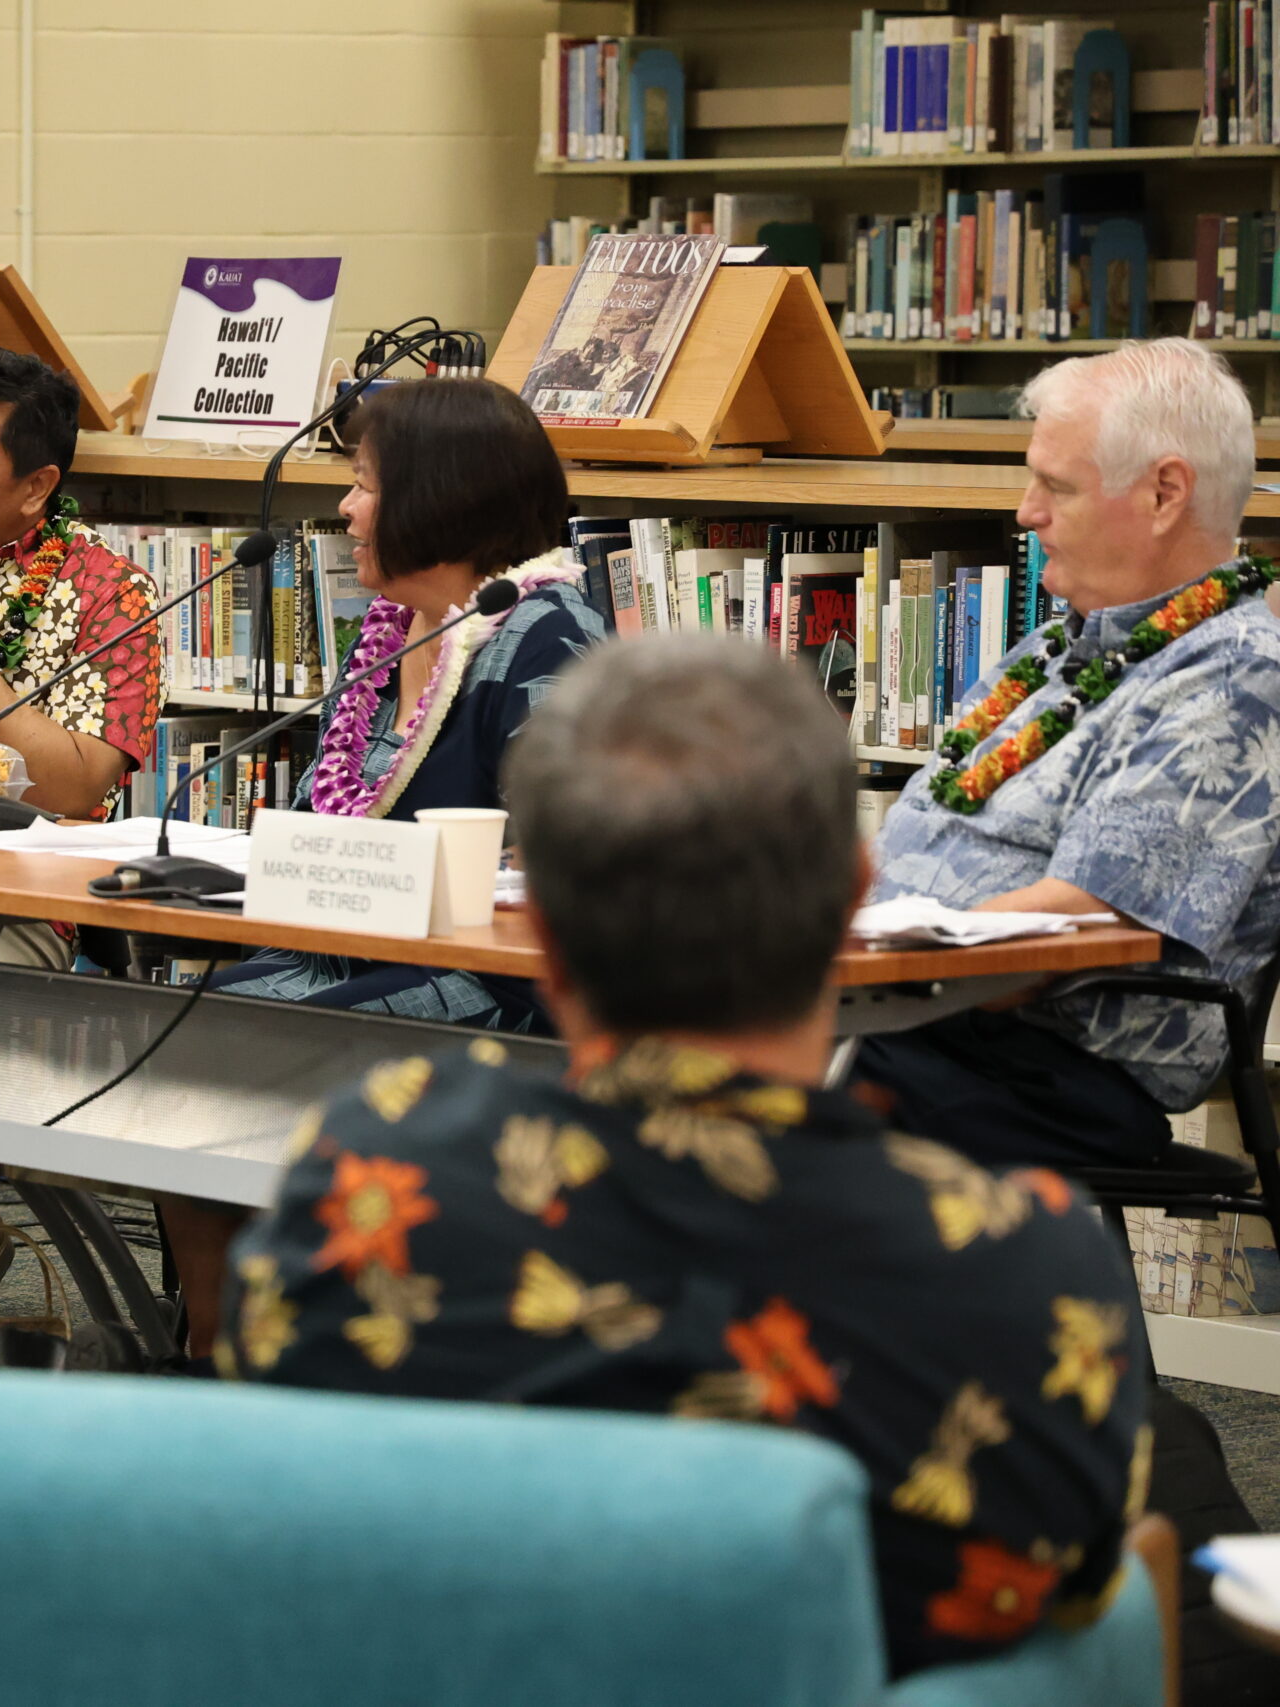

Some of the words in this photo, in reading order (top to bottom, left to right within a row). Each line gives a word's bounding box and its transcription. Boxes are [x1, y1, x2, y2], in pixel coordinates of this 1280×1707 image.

[585, 239, 711, 275] TATTOOS
[215, 353, 268, 378] Pacific
[194, 387, 274, 415] Collection
[282, 539, 290, 562] IAN
[662, 526, 670, 550] PEARL
[780, 530, 816, 554] THE
[273, 541, 281, 575] TOLL
[294, 542, 302, 572] WAR
[612, 557, 630, 569] LONG
[664, 550, 673, 582] HARBOR
[294, 573, 302, 587] IN
[1025, 571, 1034, 606] PACIFIC
[294, 588, 302, 613] THE
[789, 594, 801, 632] WAKE
[937, 602, 945, 617] The
[181, 604, 189, 625] AND
[222, 590, 231, 647] STRAGGLERS
[282, 599, 290, 648] PACIFIC
[181, 627, 189, 652] WAR
[294, 615, 302, 662] PACIFIC
[936, 641, 944, 667] Pacific
[290, 834, 334, 855] CHIEF
[338, 839, 397, 862] JUSTICE
[262, 860, 304, 880] MARK
[306, 889, 372, 914] RETIRED
